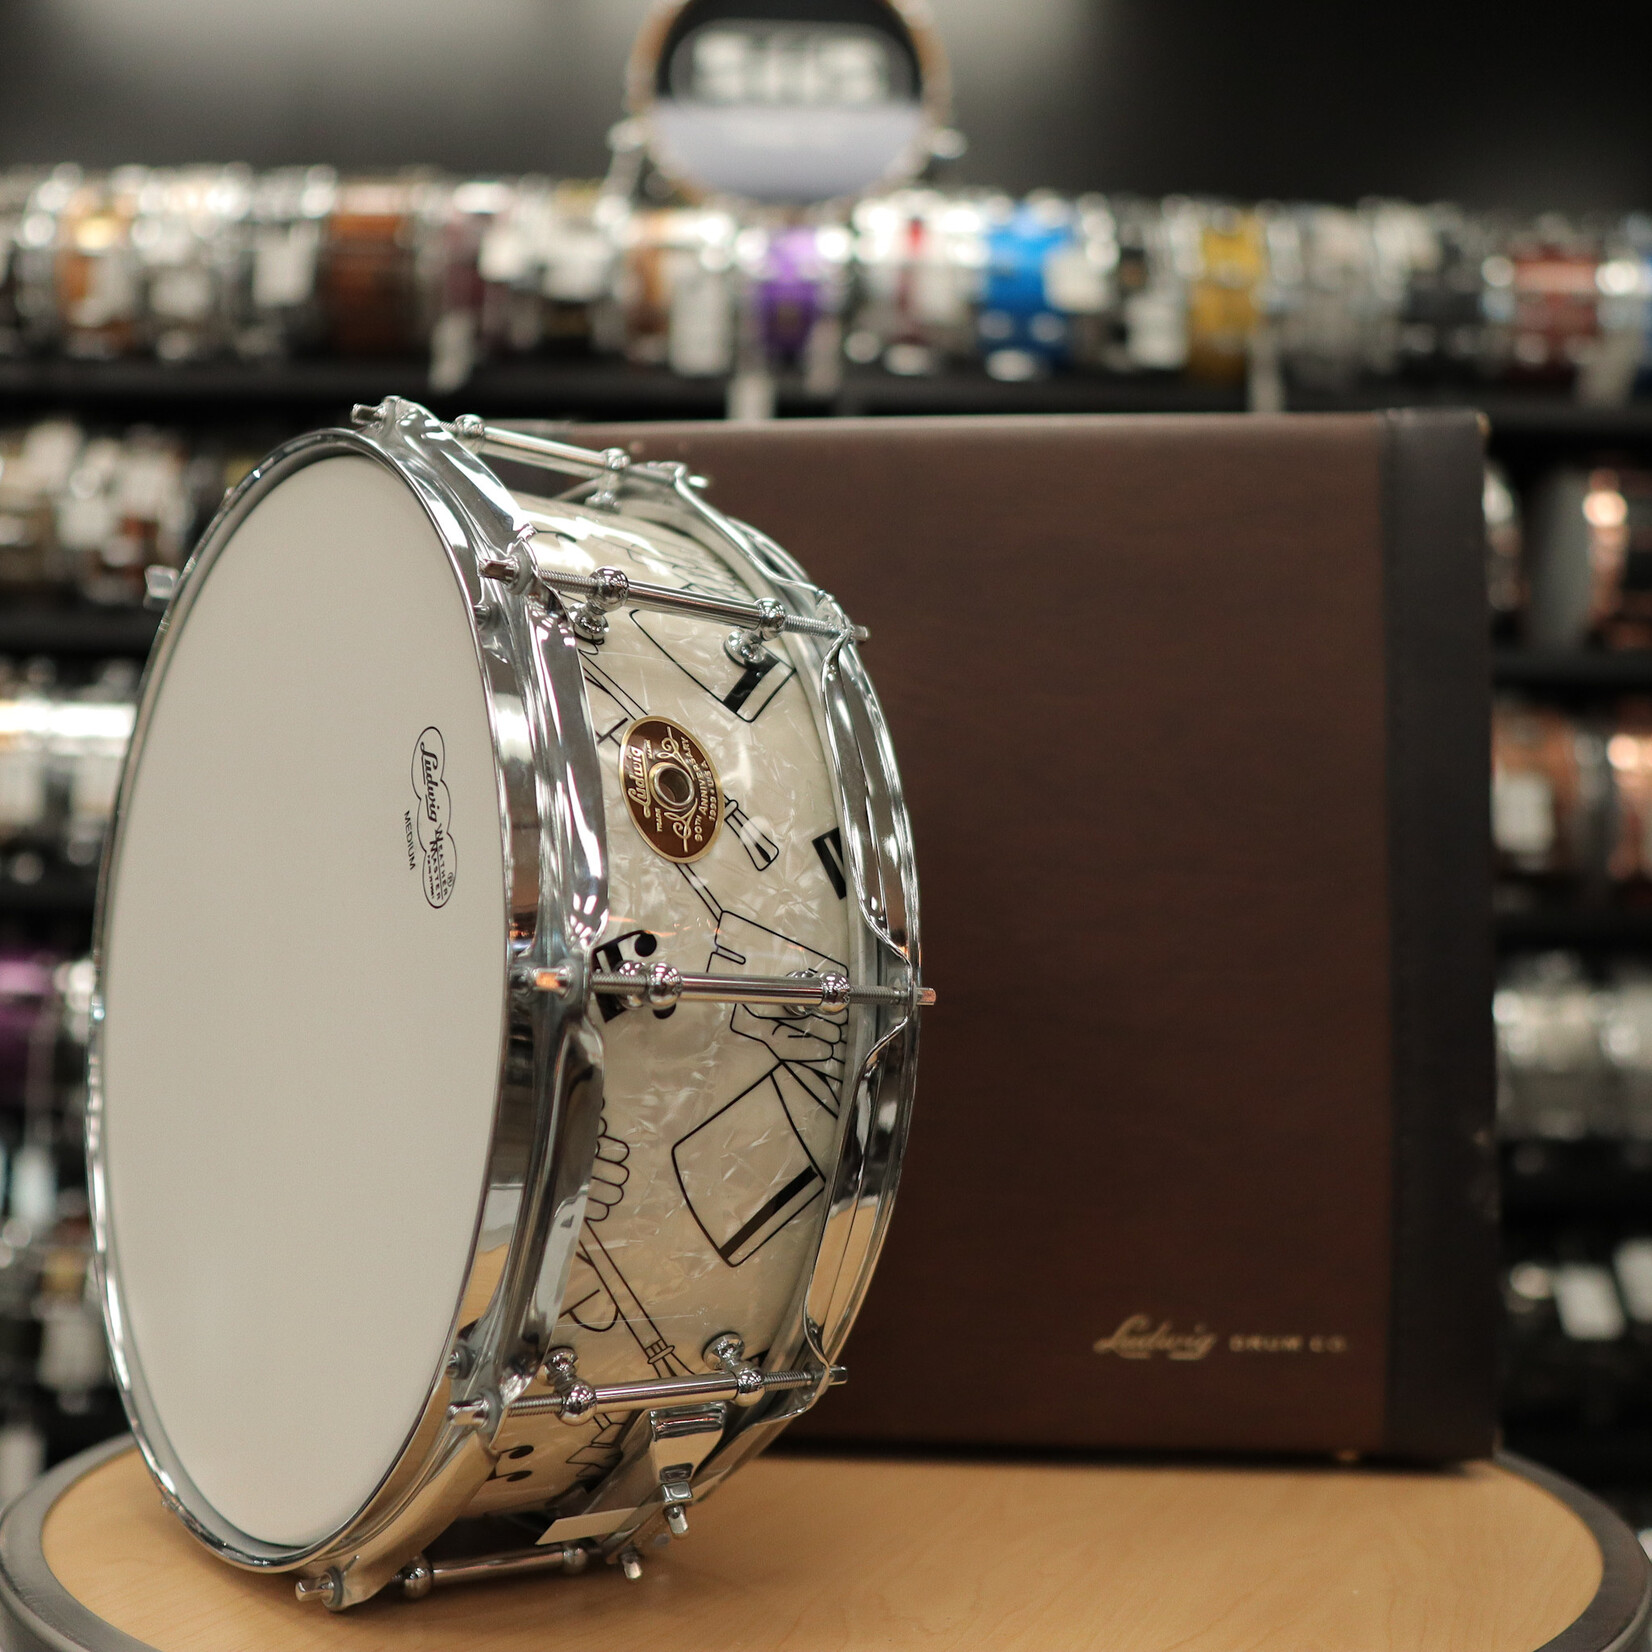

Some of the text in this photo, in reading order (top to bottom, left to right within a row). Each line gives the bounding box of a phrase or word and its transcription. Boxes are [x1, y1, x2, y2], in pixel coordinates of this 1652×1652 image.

[420, 741, 440, 823] Ludwig
[627, 745, 652, 818] Ludwig
[681, 736, 709, 816] ANNIVERSARY
[708, 796, 717, 821] 1999
[404, 810, 416, 871] MEDIUM
[1093, 1314, 1217, 1360] Ludwig
